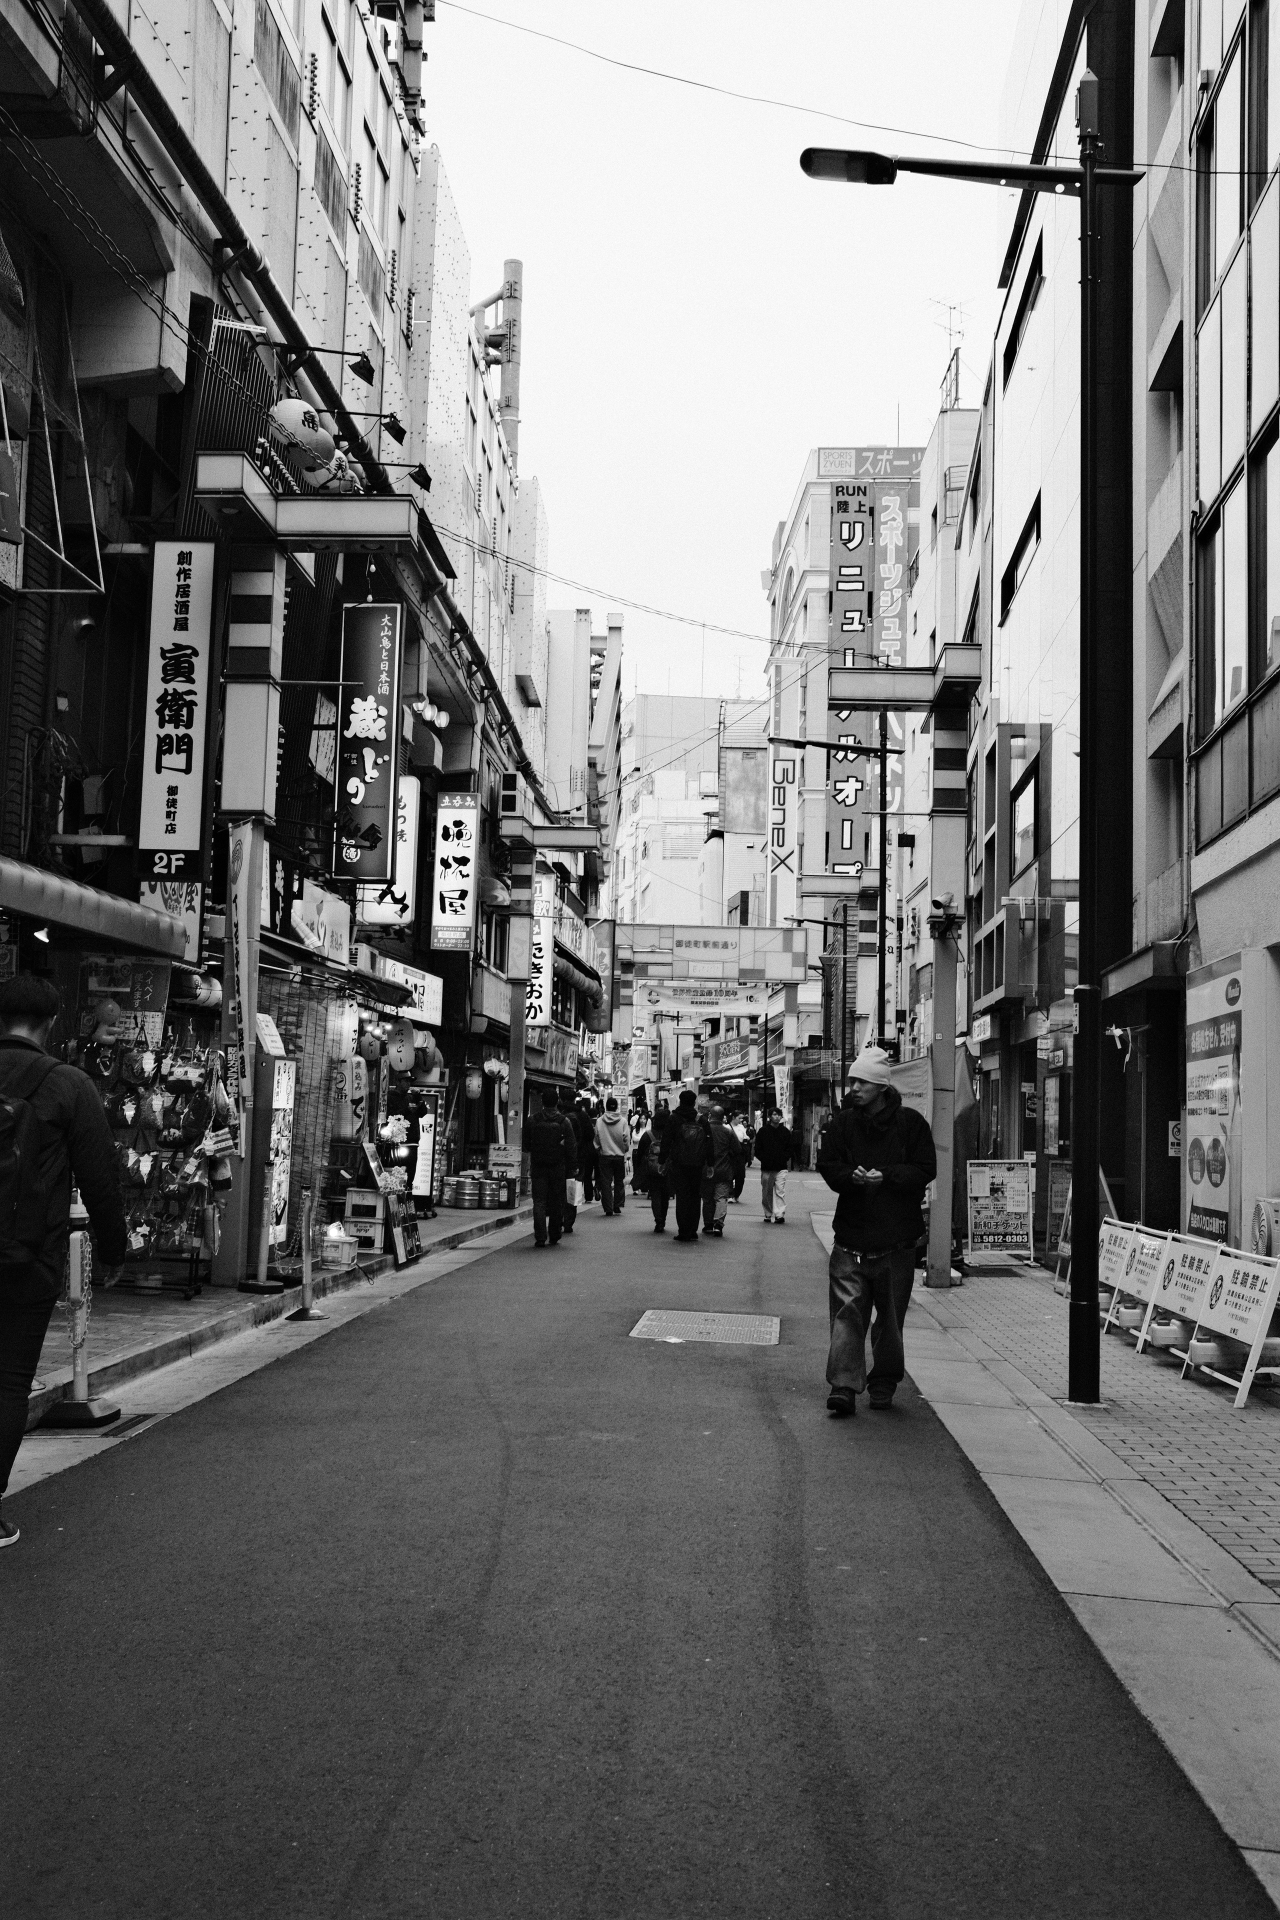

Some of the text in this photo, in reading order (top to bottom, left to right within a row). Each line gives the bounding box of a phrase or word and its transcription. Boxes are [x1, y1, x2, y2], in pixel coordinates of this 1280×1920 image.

[823, 451, 852, 460] SPORTS
[823, 460, 852, 469] ZYUEN
[835, 486, 867, 497] RUN
[836, 501, 867, 514] 陸上
[172, 550, 193, 632] 創作居酒屋
[155, 642, 200, 775] 寅衛門
[164, 784, 179, 835] 御徒町店
[152, 852, 186, 875] 2F
[675, 939, 743, 951] 御徒町駅前通り
[1219, 1020, 1237, 1047] 受付中
[973, 1221, 1028, 1231] 新和チケット
[1180, 1253, 1210, 1275] 駐輪禁止
[1231, 1269, 1268, 1293] 駐輪禁止
